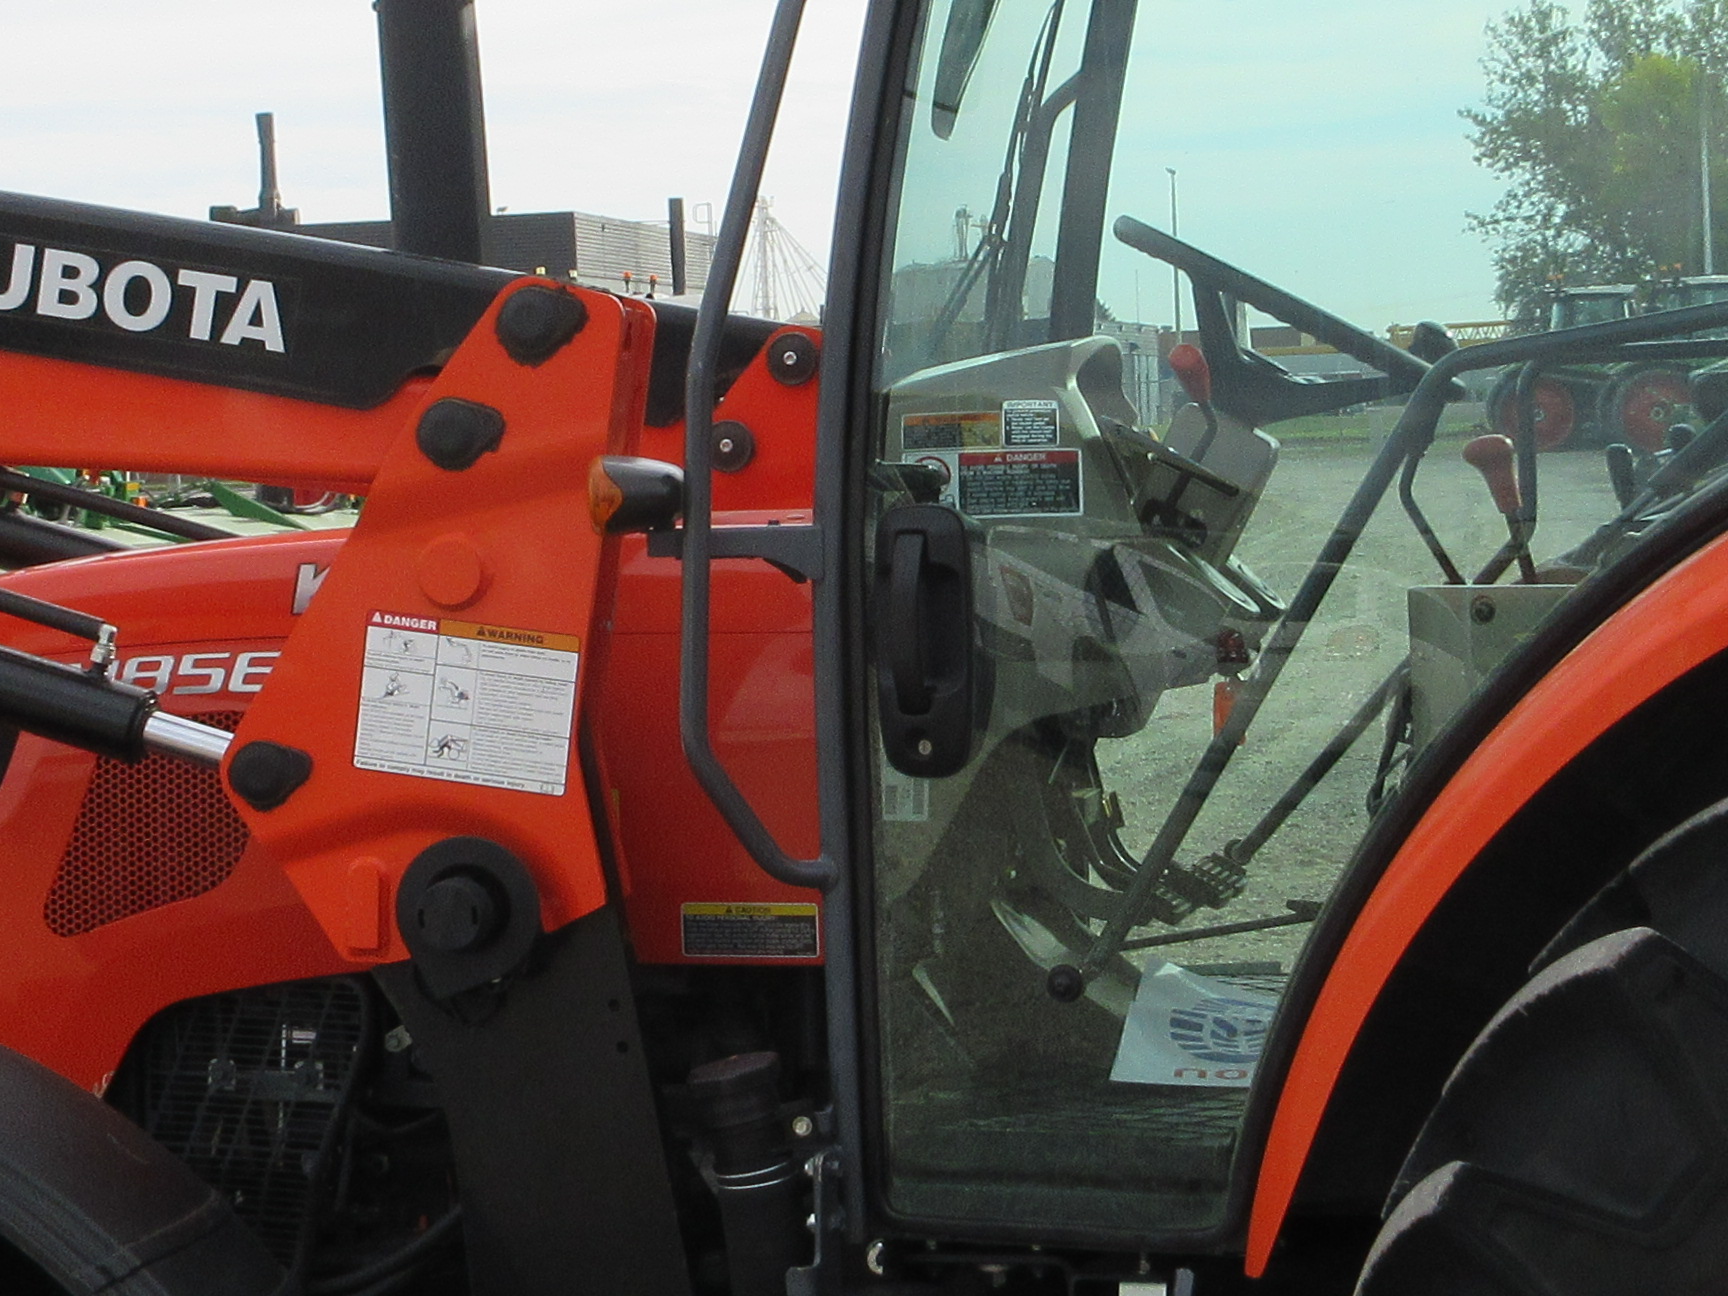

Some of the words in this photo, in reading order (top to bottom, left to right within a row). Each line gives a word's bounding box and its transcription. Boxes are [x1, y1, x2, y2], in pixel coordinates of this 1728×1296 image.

[1006, 453, 1047, 462] DANGER
[383, 614, 438, 631] DANGER
[488, 629, 544, 645] WARNING
[735, 906, 771, 914] CAUTION
